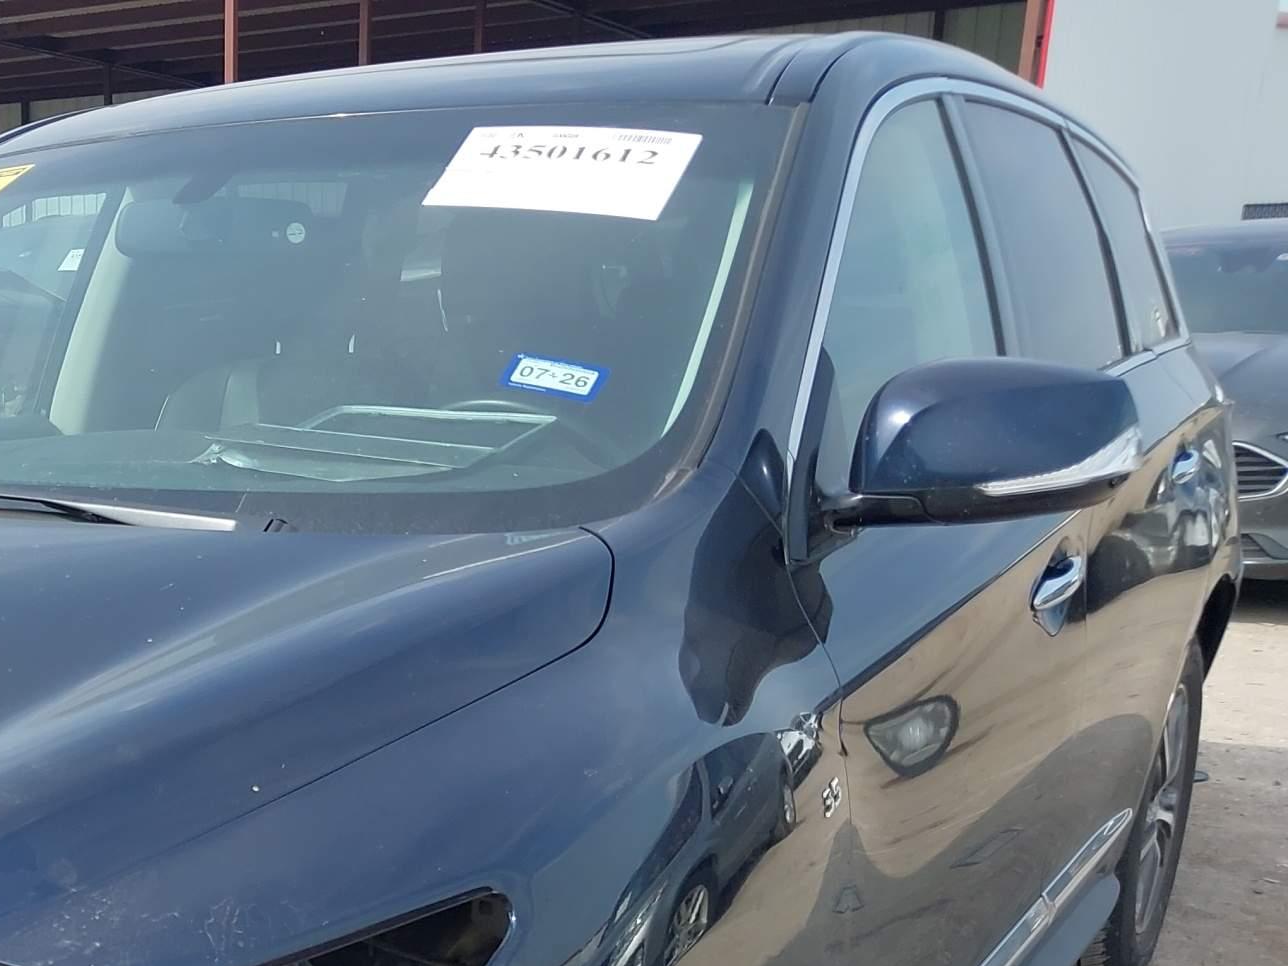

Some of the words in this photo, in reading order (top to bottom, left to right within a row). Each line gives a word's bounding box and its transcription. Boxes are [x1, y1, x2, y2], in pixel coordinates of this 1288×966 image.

[480, 144, 659, 165] 43501612
[519, 365, 550, 380] 07
[559, 372, 590, 388] 26
